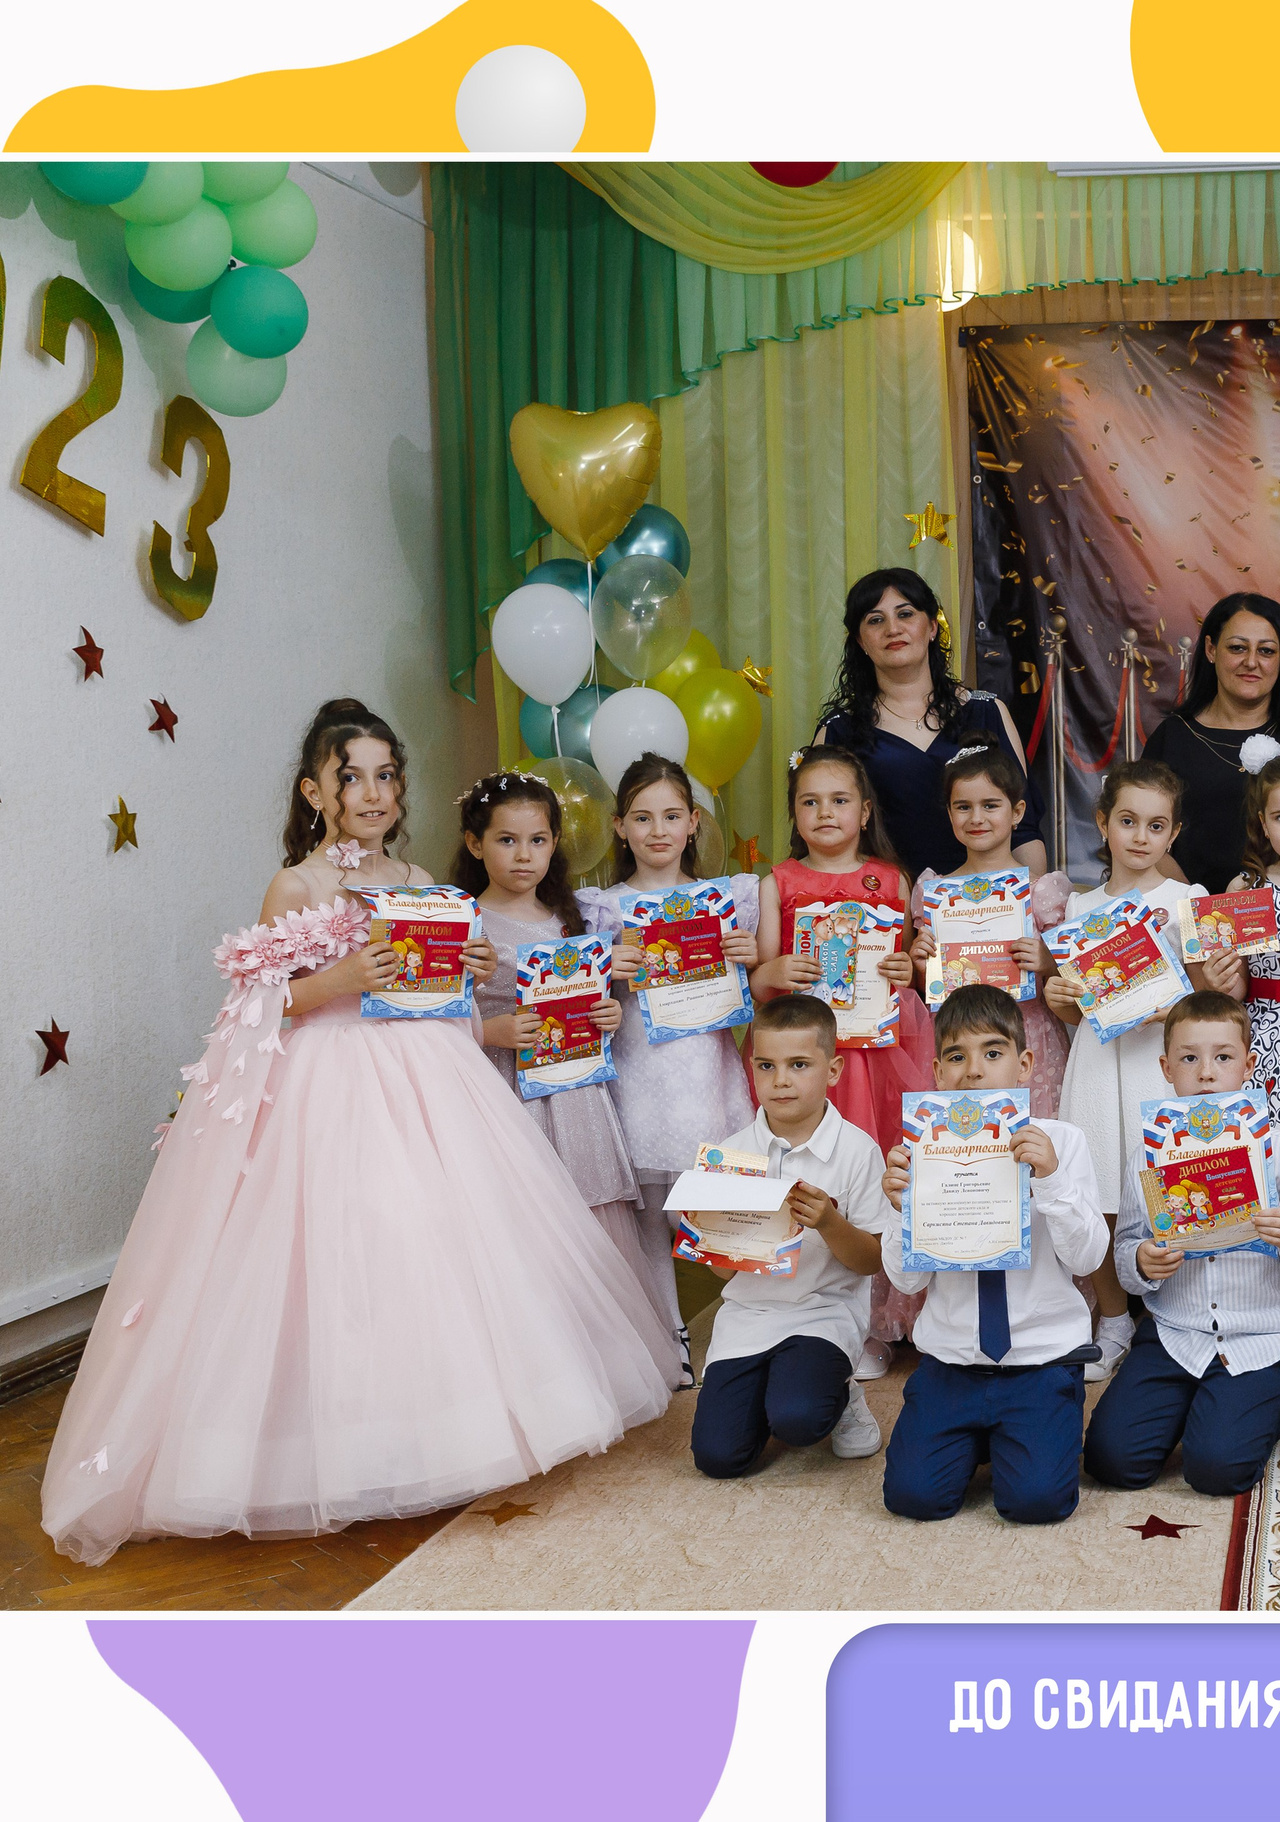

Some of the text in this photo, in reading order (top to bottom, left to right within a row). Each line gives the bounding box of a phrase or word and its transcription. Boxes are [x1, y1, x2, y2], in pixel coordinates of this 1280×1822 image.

[385, 898, 462, 911] Благодарность
[1211, 894, 1257, 911] ДИПЛОМ
[941, 904, 1014, 919] Благодарность
[405, 925, 452, 936] ДИПЛОМ
[959, 944, 1004, 956] ДИПЛОМ
[1090, 933, 1132, 962] ДИПЛОМ
[830, 950, 838, 972] САДА
[532, 979, 598, 998] Благодарность
[923, 1142, 1010, 1158] Благодарность
[1179, 1156, 1230, 1179] ДИПЛОМ
[1206, 1167, 1247, 1181] Выпускнику
